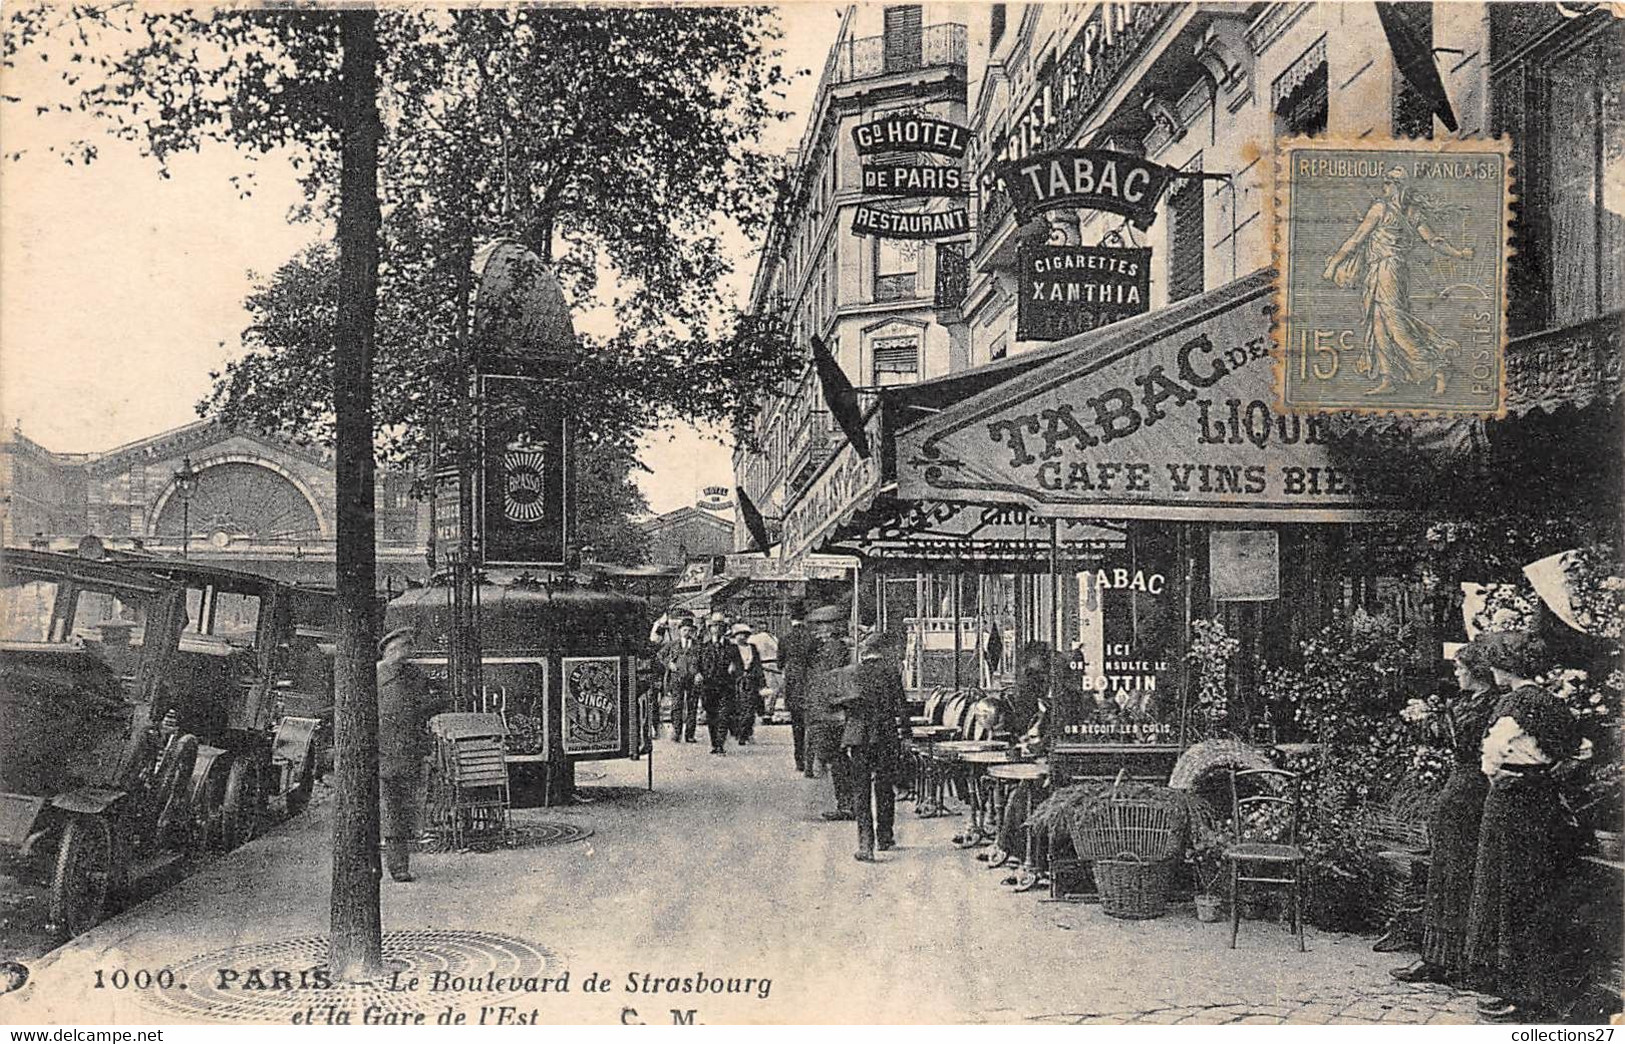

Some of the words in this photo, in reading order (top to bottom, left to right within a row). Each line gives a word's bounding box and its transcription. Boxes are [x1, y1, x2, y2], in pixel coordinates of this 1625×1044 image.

[888, 121, 962, 150] HOTEL
[865, 171, 888, 187] DE
[894, 168, 959, 189] PARIS
[1020, 158, 1150, 202] TABAC
[857, 208, 965, 232] RESTAURANT
[1034, 257, 1139, 277] CIGARETTES
[1032, 281, 1141, 304] XANTHIA
[1471, 310, 1491, 395] POSTES
[989, 333, 1229, 468] TABAC
[1037, 463, 1151, 492] CAFE
[1170, 465, 1265, 494] VINS
[1076, 568, 1165, 594] TABAC
[1106, 644, 1130, 655] ICI
[1069, 661, 1083, 670] ON
[1090, 661, 1149, 671] NSULTE
[1155, 661, 1167, 671] LE
[1082, 675, 1156, 691] BOTTIN
[578, 691, 613, 714] SINGER
[1064, 725, 1078, 734] ON
